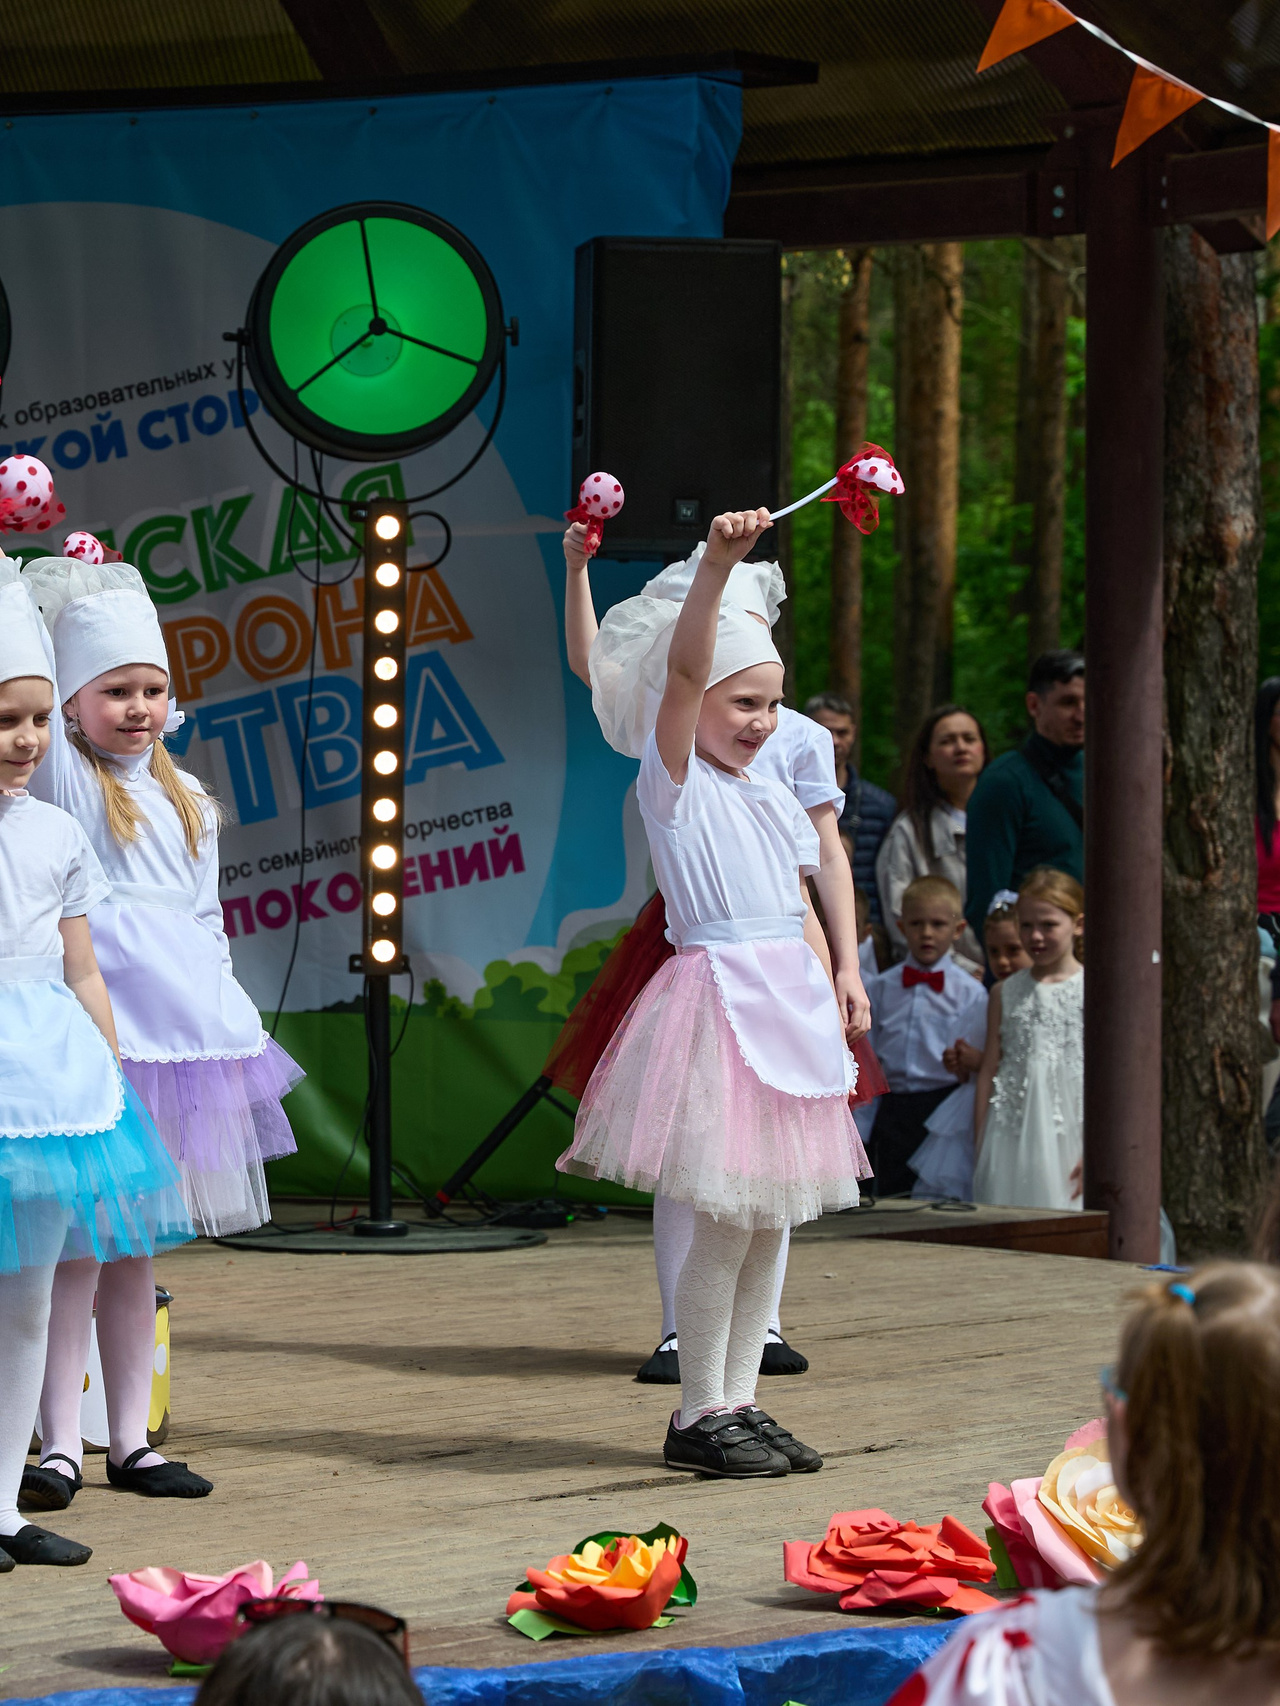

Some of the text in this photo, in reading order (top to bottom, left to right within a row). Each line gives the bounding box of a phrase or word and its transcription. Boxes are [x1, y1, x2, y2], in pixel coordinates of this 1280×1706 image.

[14, 362, 217, 425] образовательных
[137, 387, 272, 451] СТОР
[222, 825, 525, 938] ПОКОЕНИЙ
